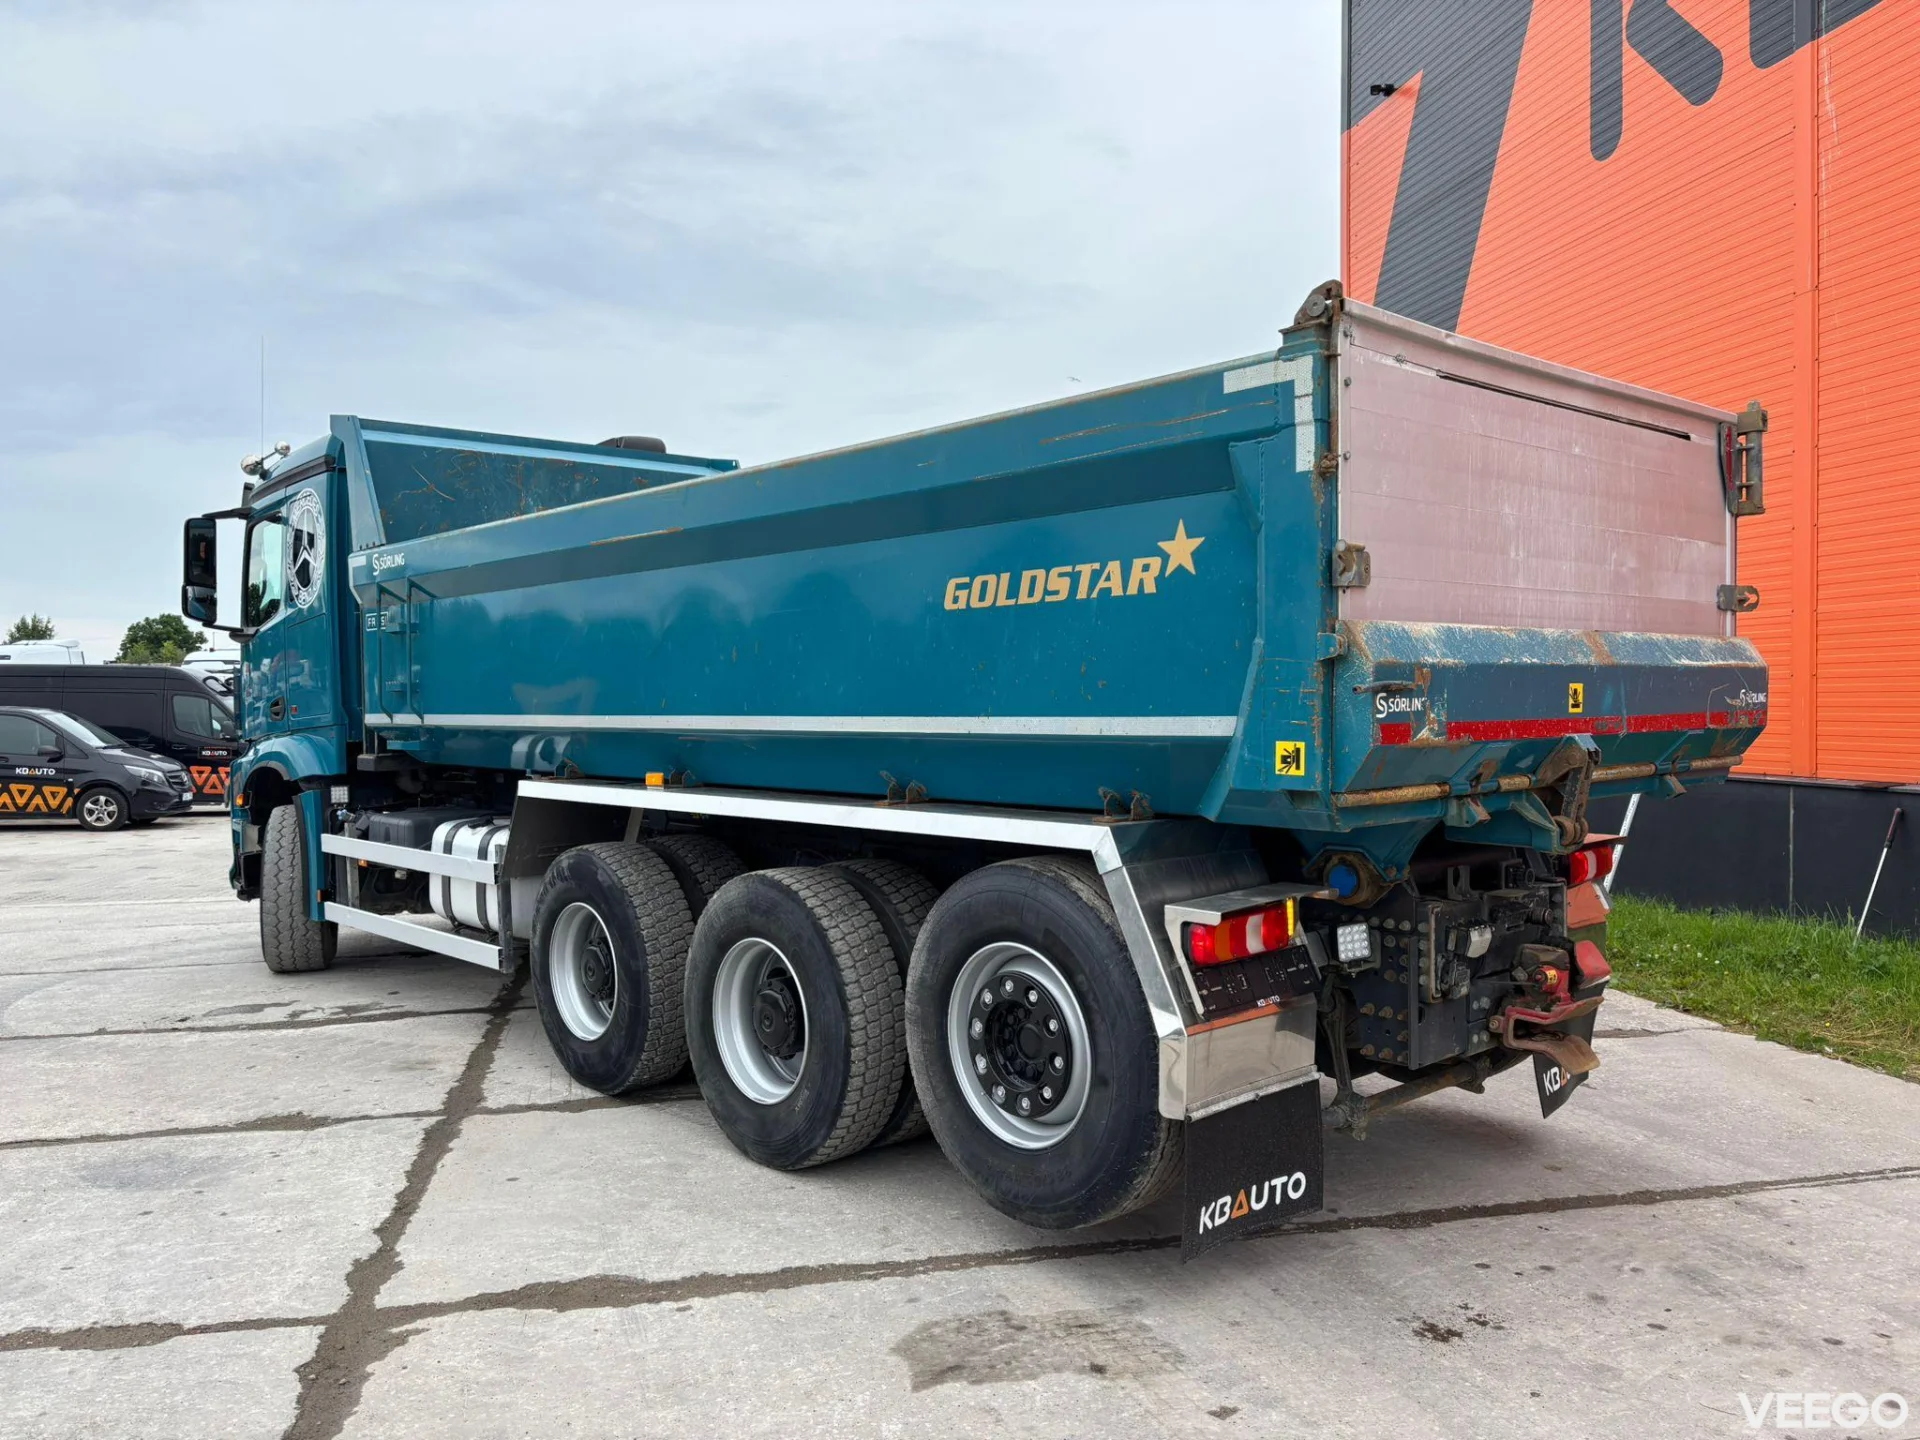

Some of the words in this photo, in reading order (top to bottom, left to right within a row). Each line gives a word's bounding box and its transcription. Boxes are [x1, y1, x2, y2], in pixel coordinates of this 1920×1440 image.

[944, 556, 1162, 610] GOLDSTAR
[15, 767, 56, 775] KBAUTO
[1199, 1171, 1307, 1235] KBAUTO
